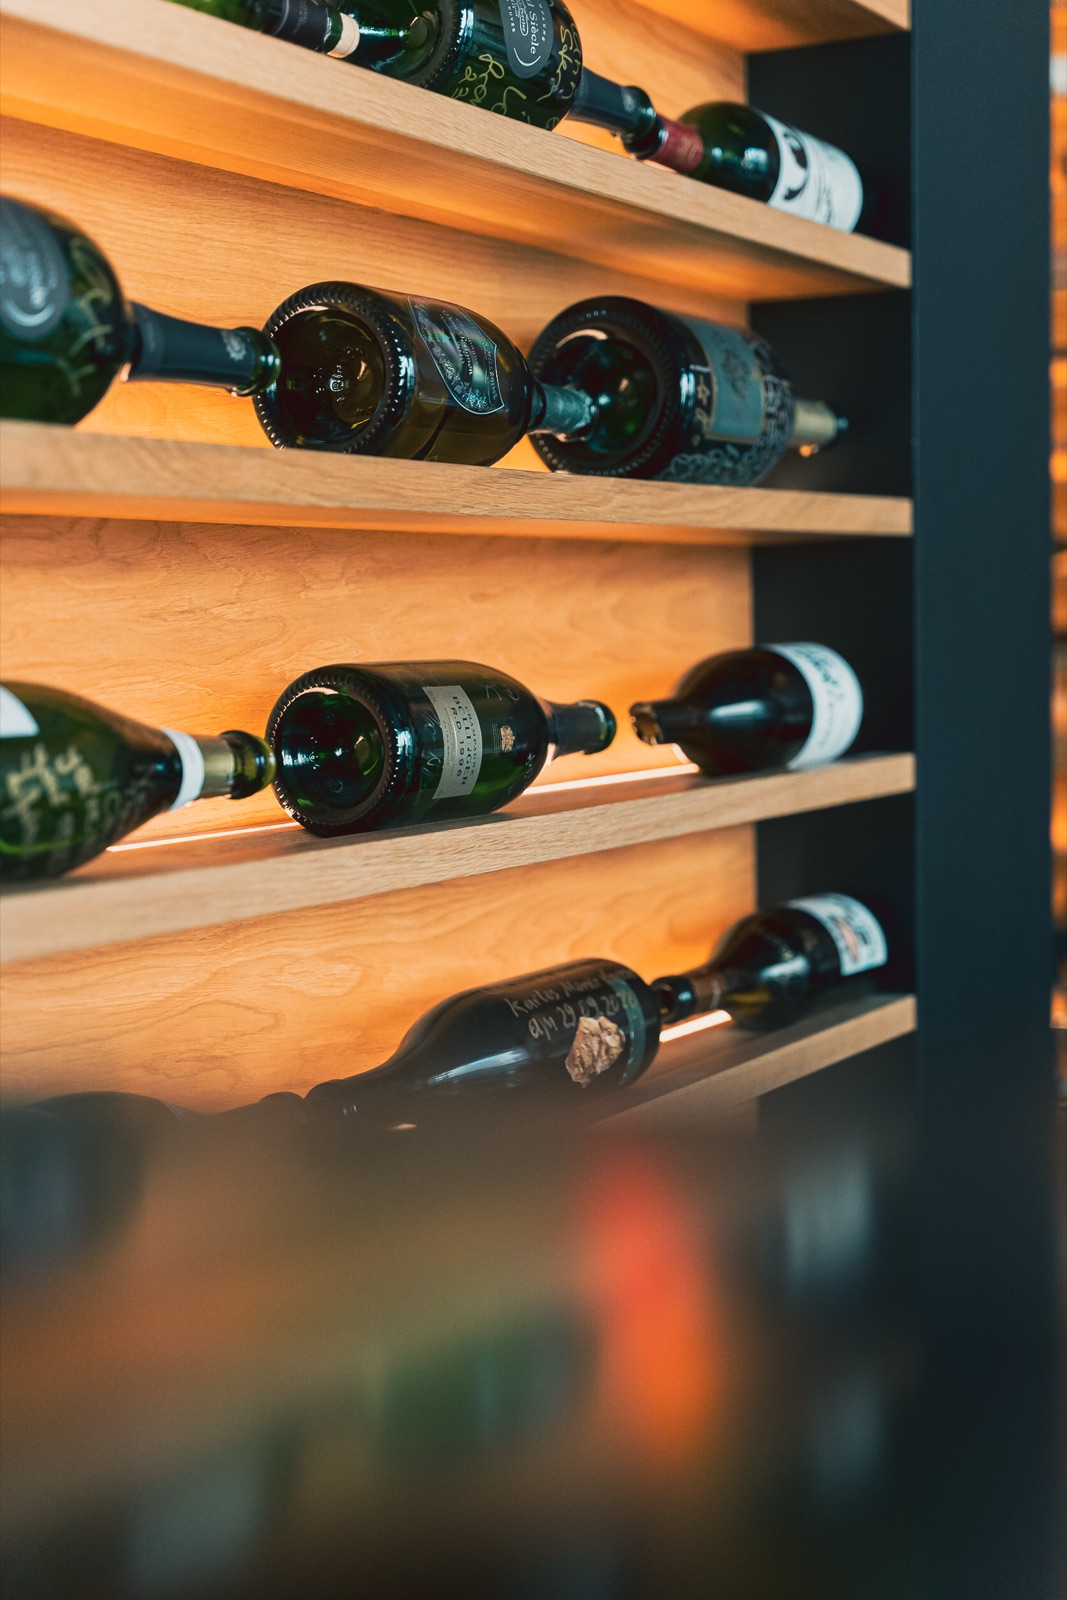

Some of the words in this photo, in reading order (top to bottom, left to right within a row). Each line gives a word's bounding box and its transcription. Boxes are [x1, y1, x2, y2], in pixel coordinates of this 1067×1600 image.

[529, 11, 540, 55] Siècle
[456, 740, 465, 777] 1996
[464, 705, 477, 777] CHAMPAGNE
